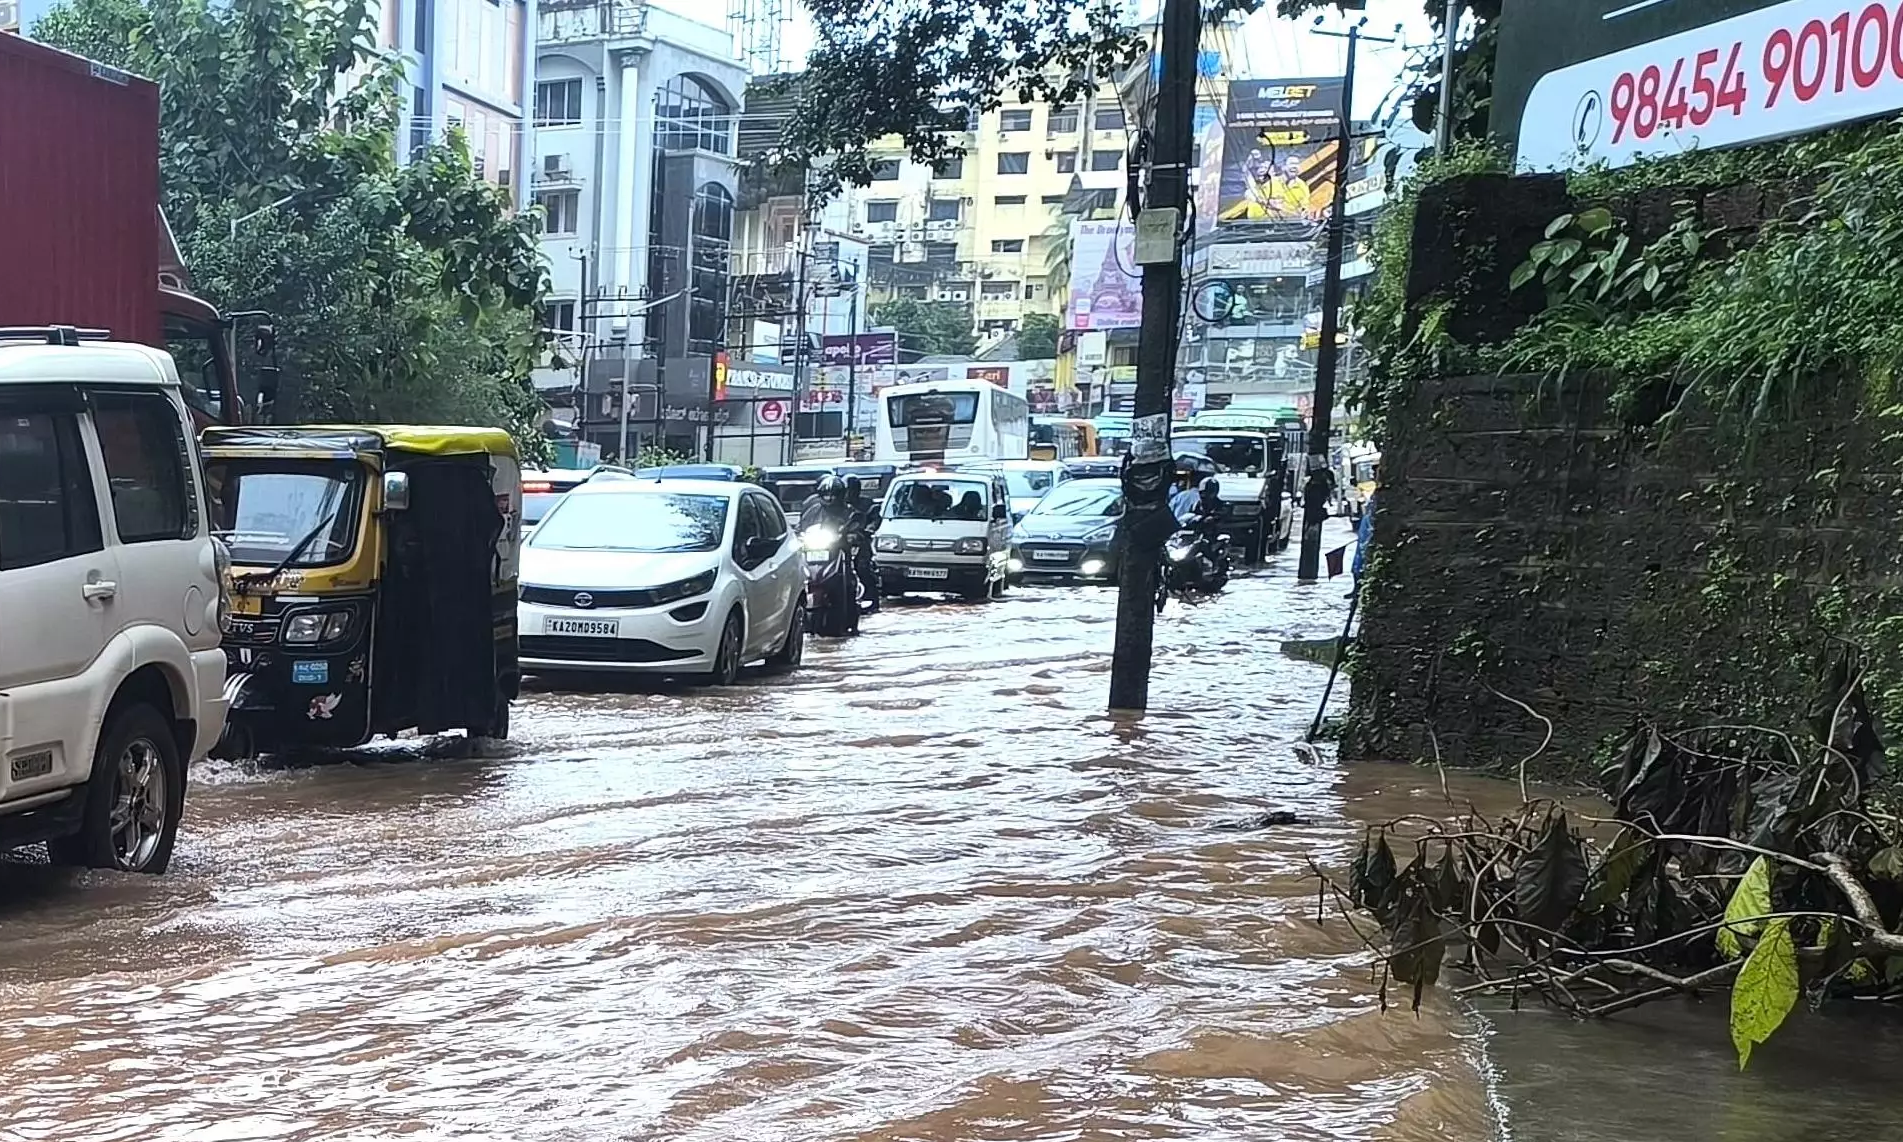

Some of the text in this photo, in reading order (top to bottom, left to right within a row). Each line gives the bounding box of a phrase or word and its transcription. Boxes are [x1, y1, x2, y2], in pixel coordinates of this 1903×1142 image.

[1258, 86, 1316, 98] MELBET
[1611, 41, 1746, 145] 98454
[552, 621, 616, 634] KA20MD9584
